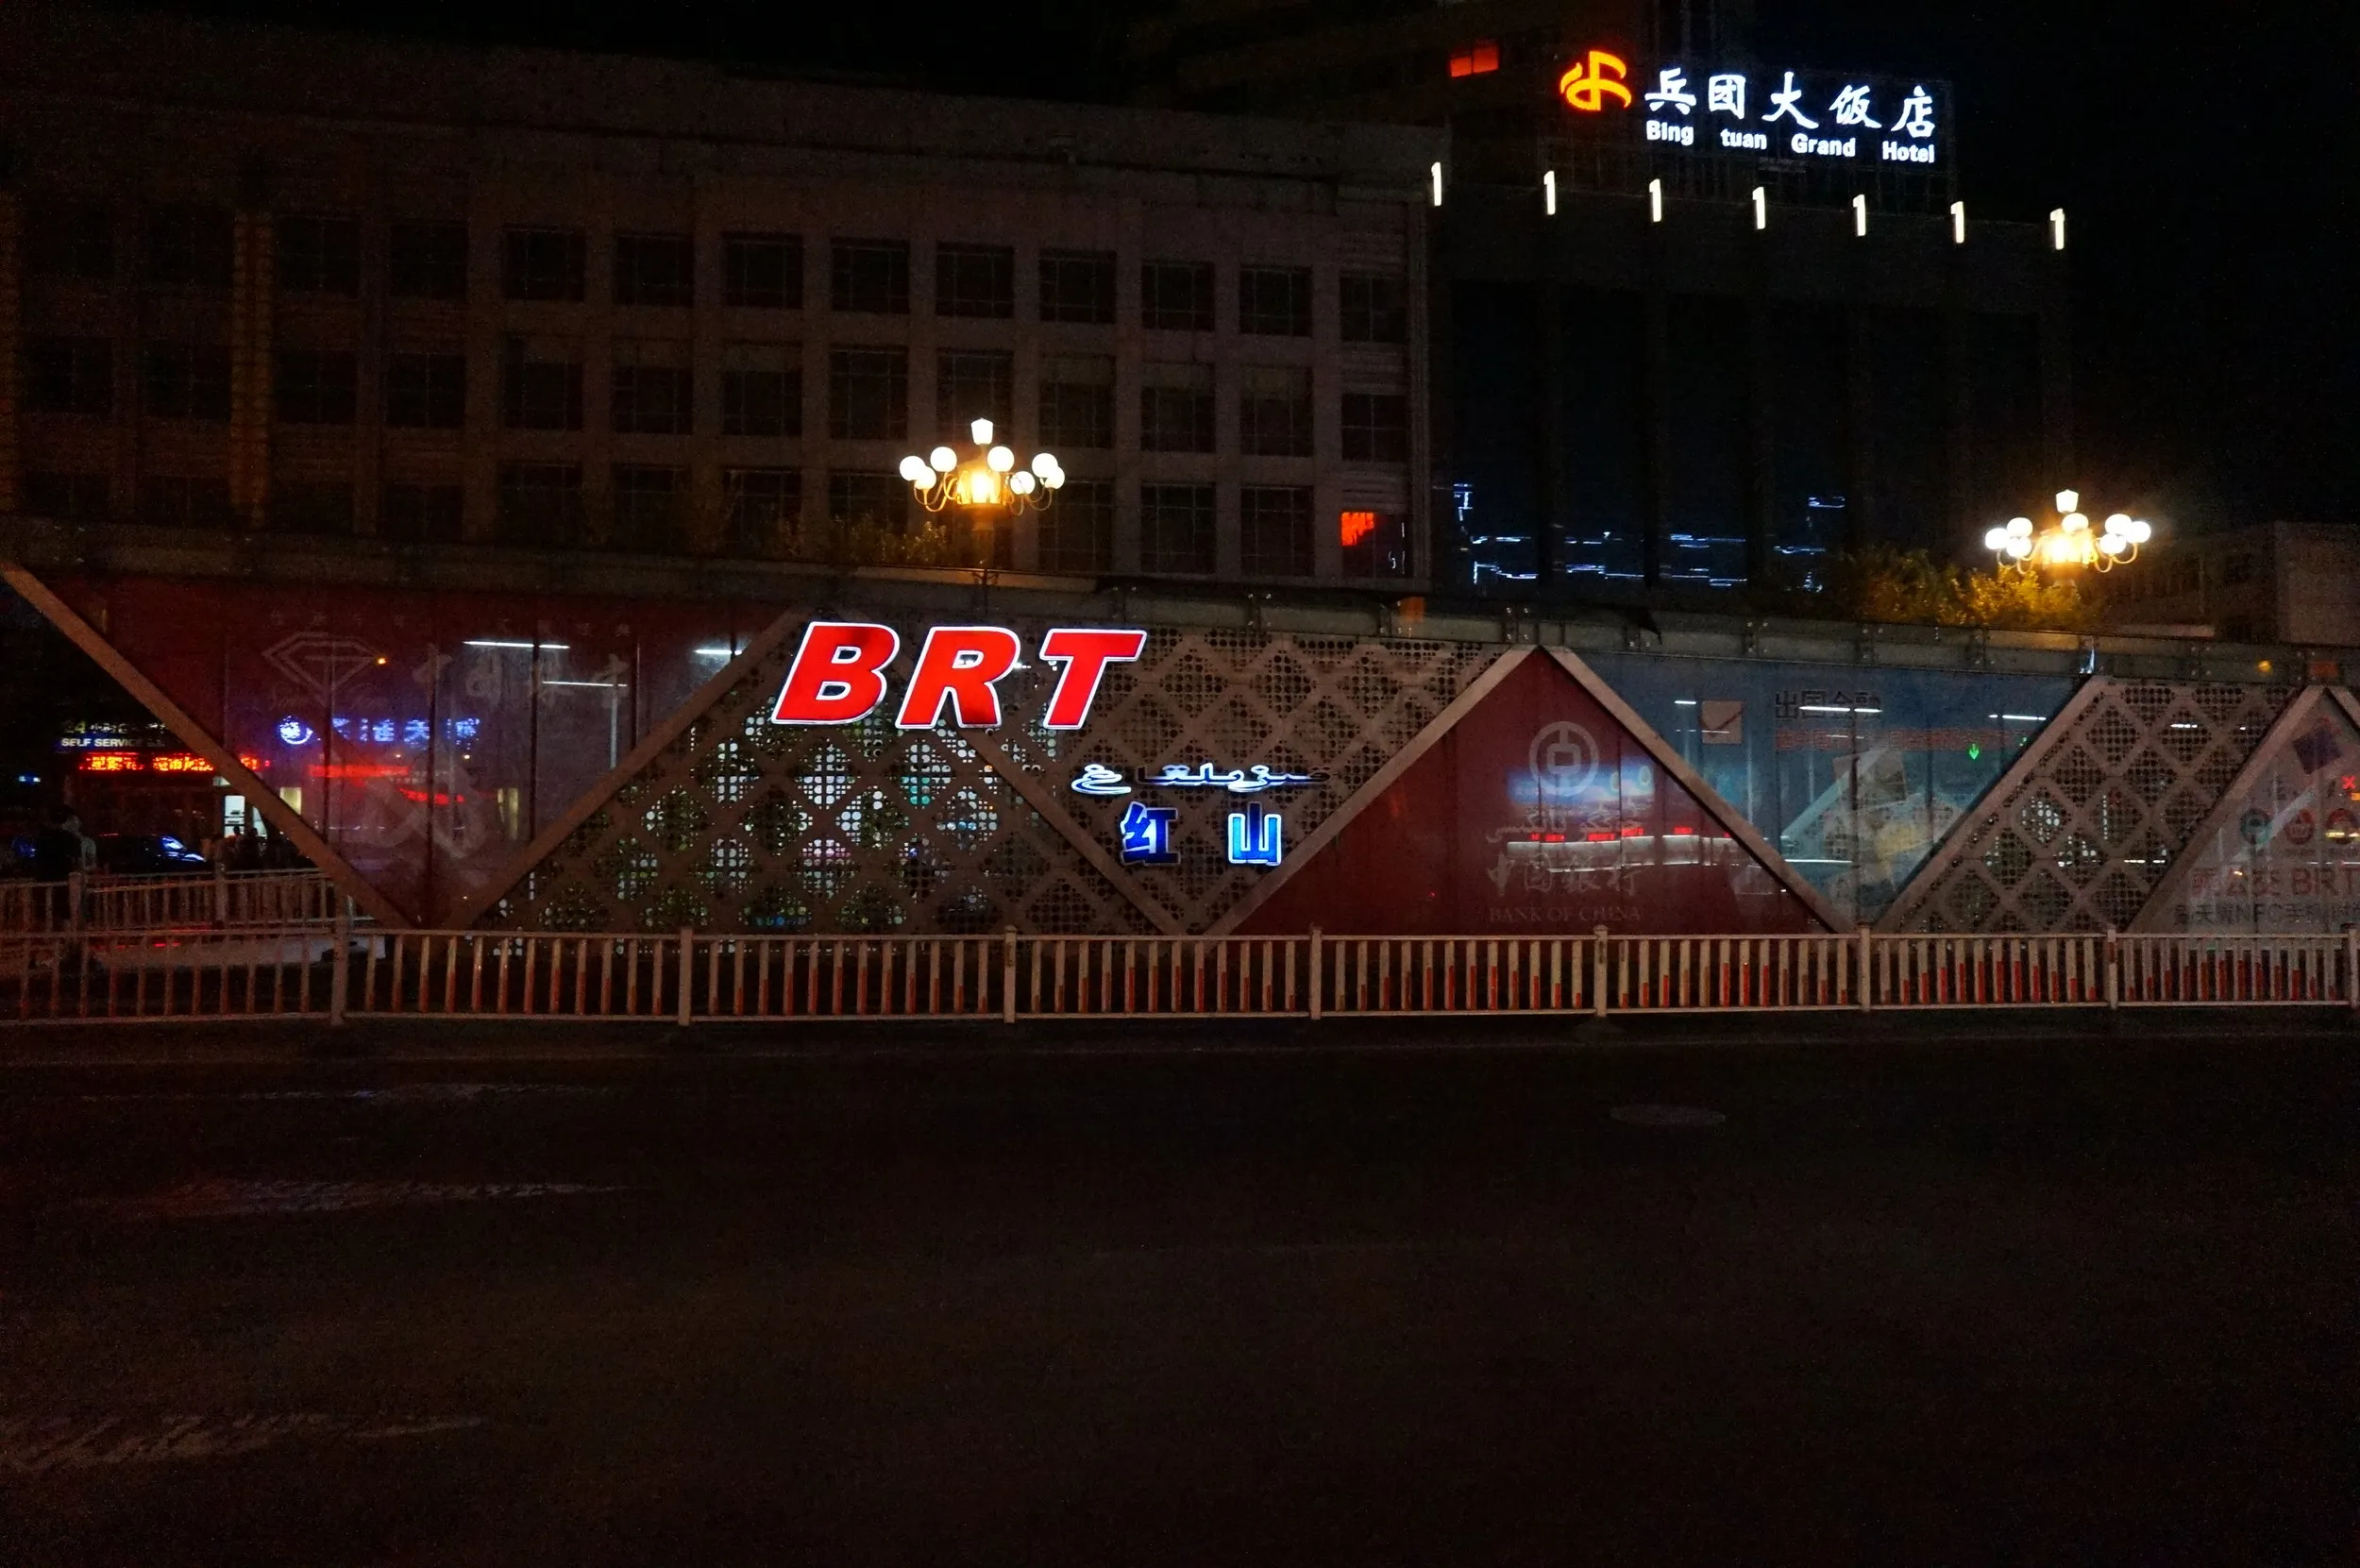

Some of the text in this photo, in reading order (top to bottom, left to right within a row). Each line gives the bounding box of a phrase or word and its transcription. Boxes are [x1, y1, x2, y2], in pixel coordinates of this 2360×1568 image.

[1644, 67, 1936, 139] 兵团大饭店
[1645, 120, 1935, 164] Bing tuan Grand Hotel
[770, 621, 1147, 730] BRT
[60, 737, 92, 748] SELF
[94, 737, 143, 748] SERVICE
[1121, 801, 1282, 867] 红山
[1485, 850, 1644, 898] 中国银行
[1489, 905, 1643, 923] BANK OF CHINA
